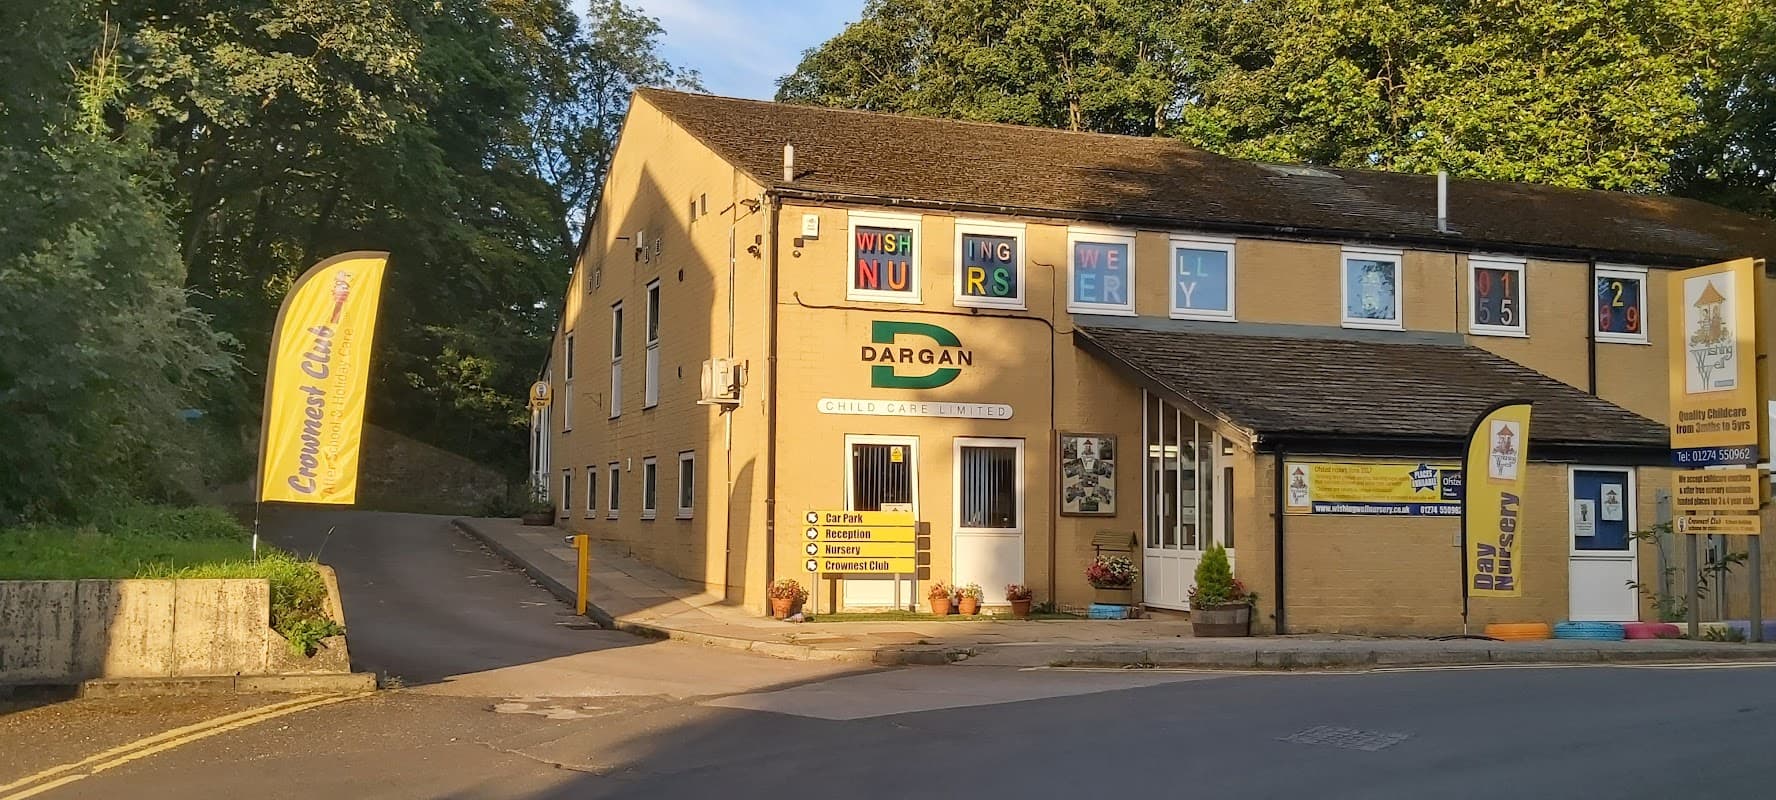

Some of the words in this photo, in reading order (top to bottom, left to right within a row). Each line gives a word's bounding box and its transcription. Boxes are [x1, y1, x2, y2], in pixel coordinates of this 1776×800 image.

[857, 232, 911, 253] WISH
[968, 240, 1010, 261] ING
[1079, 249, 1120, 270] WE
[1179, 255, 1208, 277] LL
[859, 259, 907, 290] NU
[967, 266, 1010, 296] RS
[1080, 273, 1121, 302] ER
[1179, 281, 1197, 307] Y
[1611, 281, 1624, 307] 2
[301, 325, 334, 379] Club
[861, 346, 973, 366] DARGAN
[325, 422, 344, 462] School
[337, 328, 354, 357] Care
[825, 401, 876, 413] CHILD
[887, 403, 929, 415] CARE
[939, 404, 1007, 417] LIMITED
[1679, 409, 1706, 422] Quality
[1707, 407, 1747, 420] Childcare
[1676, 423, 1694, 434] from
[1696, 421, 1721, 433] 3mths
[1722, 421, 1730, 432] to
[1731, 420, 1751, 432] 5yrs
[288, 385, 327, 494] Crownest
[1677, 451, 1691, 462] Tel:
[1692, 449, 1717, 461] 01274
[1719, 448, 1751, 460] 550962
[1413, 469, 1433, 479] PLACES
[1420, 505, 1438, 514] 01274
[825, 513, 841, 523] Car
[843, 513, 863, 523] Park
[825, 528, 871, 540] Reception
[1494, 491, 1520, 592] Nursery
[825, 544, 861, 555] Nursery
[825, 560, 868, 571] Crownest
[869, 560, 889, 571] Club
[1473, 542, 1497, 591] Day
